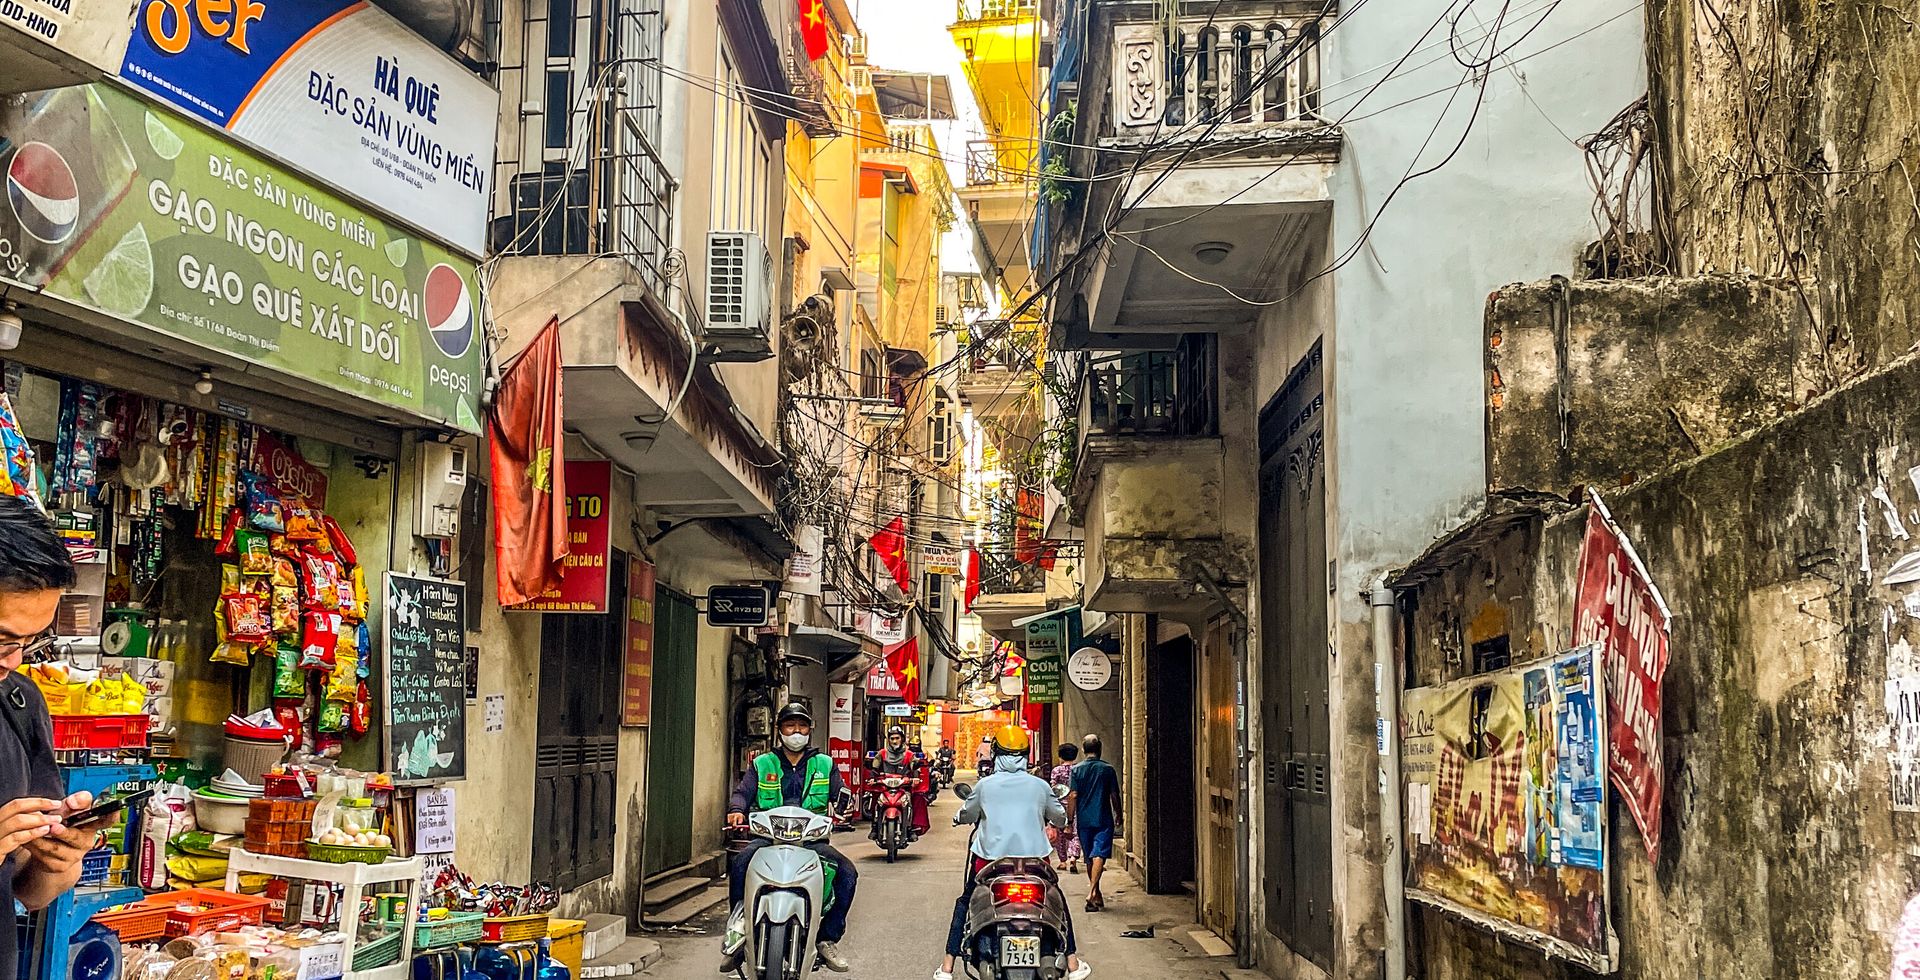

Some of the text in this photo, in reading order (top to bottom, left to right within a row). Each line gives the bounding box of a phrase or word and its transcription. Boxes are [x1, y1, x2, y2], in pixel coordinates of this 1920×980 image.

[374, 55, 440, 125] HÀ QUÊ
[308, 70, 484, 194] ĐẶC SẢN VÙNG MIỀN
[208, 155, 376, 250] ĐẶC SẢN VÙNG MIỀN
[148, 178, 419, 325] GẠO NGON CÁC LOẠI
[177, 253, 400, 365] GẠO QUÊ XÁT DỐI
[430, 364, 470, 394] pepsi
[272, 448, 314, 499] Oishi
[578, 496, 601, 517] TO
[594, 552, 603, 567] CÁ
[422, 584, 458, 606] Hôm Nay
[1029, 660, 1059, 673] CƠM
[1029, 683, 1046, 694] CƠM
[1416, 709, 1435, 737] Quê
[1007, 939, 1018, 952] 29
[1007, 953, 1035, 965] 7549
